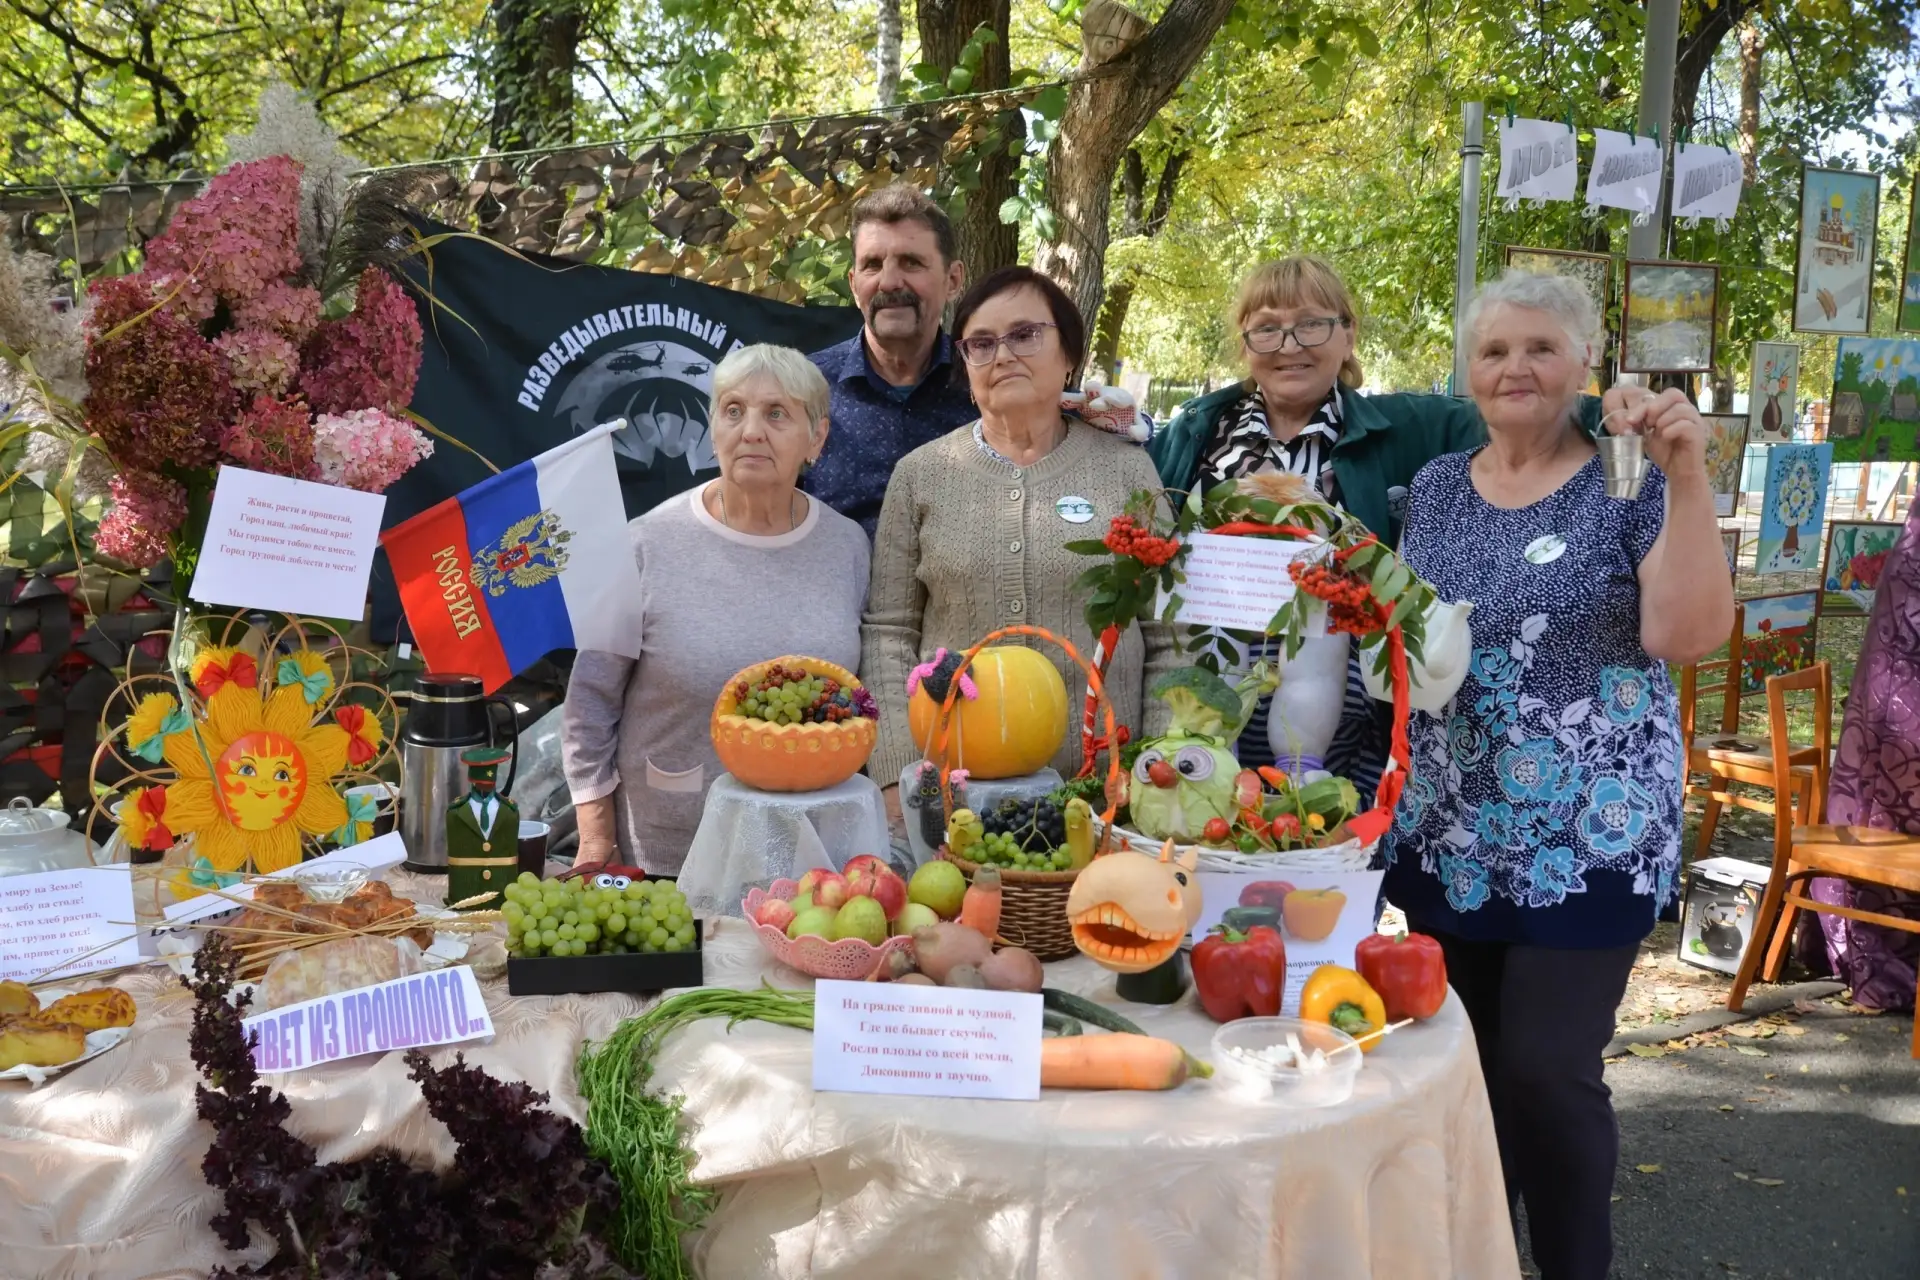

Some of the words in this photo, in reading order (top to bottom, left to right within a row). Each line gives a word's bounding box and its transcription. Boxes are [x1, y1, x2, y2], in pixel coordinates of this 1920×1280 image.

[517, 303, 727, 412] РАЗВЕДЫВАТЕЛЬНЫЙ
[247, 496, 274, 510] Живи,
[275, 504, 300, 514] расти
[308, 509, 352, 525] процветай,
[240, 512, 265, 525] Город
[287, 523, 329, 536] любимый
[329, 531, 353, 540] край!
[227, 527, 244, 539] Мы
[245, 533, 285, 544] гордимся
[286, 539, 312, 550] тобою
[219, 543, 245, 557] Город
[247, 550, 286, 562] трудовой
[287, 556, 324, 568] доблести
[332, 563, 357, 573] чести!
[432, 544, 482, 641] РОССИЯ
[5, 888, 31, 898] миру
[34, 886, 47, 894] на
[48, 880, 83, 892] Земле!
[6, 902, 34, 912] хлебу
[38, 901, 50, 910] на
[52, 896, 84, 907] столе!
[16, 918, 34, 927] кто
[37, 914, 60, 925] хлеб
[21, 932, 57, 944] трудов
[69, 927, 91, 938] сил!
[23, 948, 60, 960] привет
[96, 955, 117, 966] час!
[307, 1000, 340, 1062] ИЗ
[342, 968, 486, 1056] ПРОШЛОГО...
[842, 998, 860, 1010] На
[862, 1001, 906, 1014] грядке
[908, 1002, 953, 1016] дивной
[956, 1008, 965, 1017] и
[968, 1008, 1017, 1021] чудной,
[859, 1020, 881, 1034] Где
[884, 1024, 900, 1035] не
[901, 1023, 946, 1038] бывает
[842, 1041, 879, 1055] Росли
[882, 1046, 922, 1058] плоды
[925, 1049, 939, 1059] со
[942, 1047, 970, 1060] всей
[860, 1064, 932, 1080] Диковинно
[934, 1070, 943, 1080] и
[947, 1071, 992, 1085] звучно.
